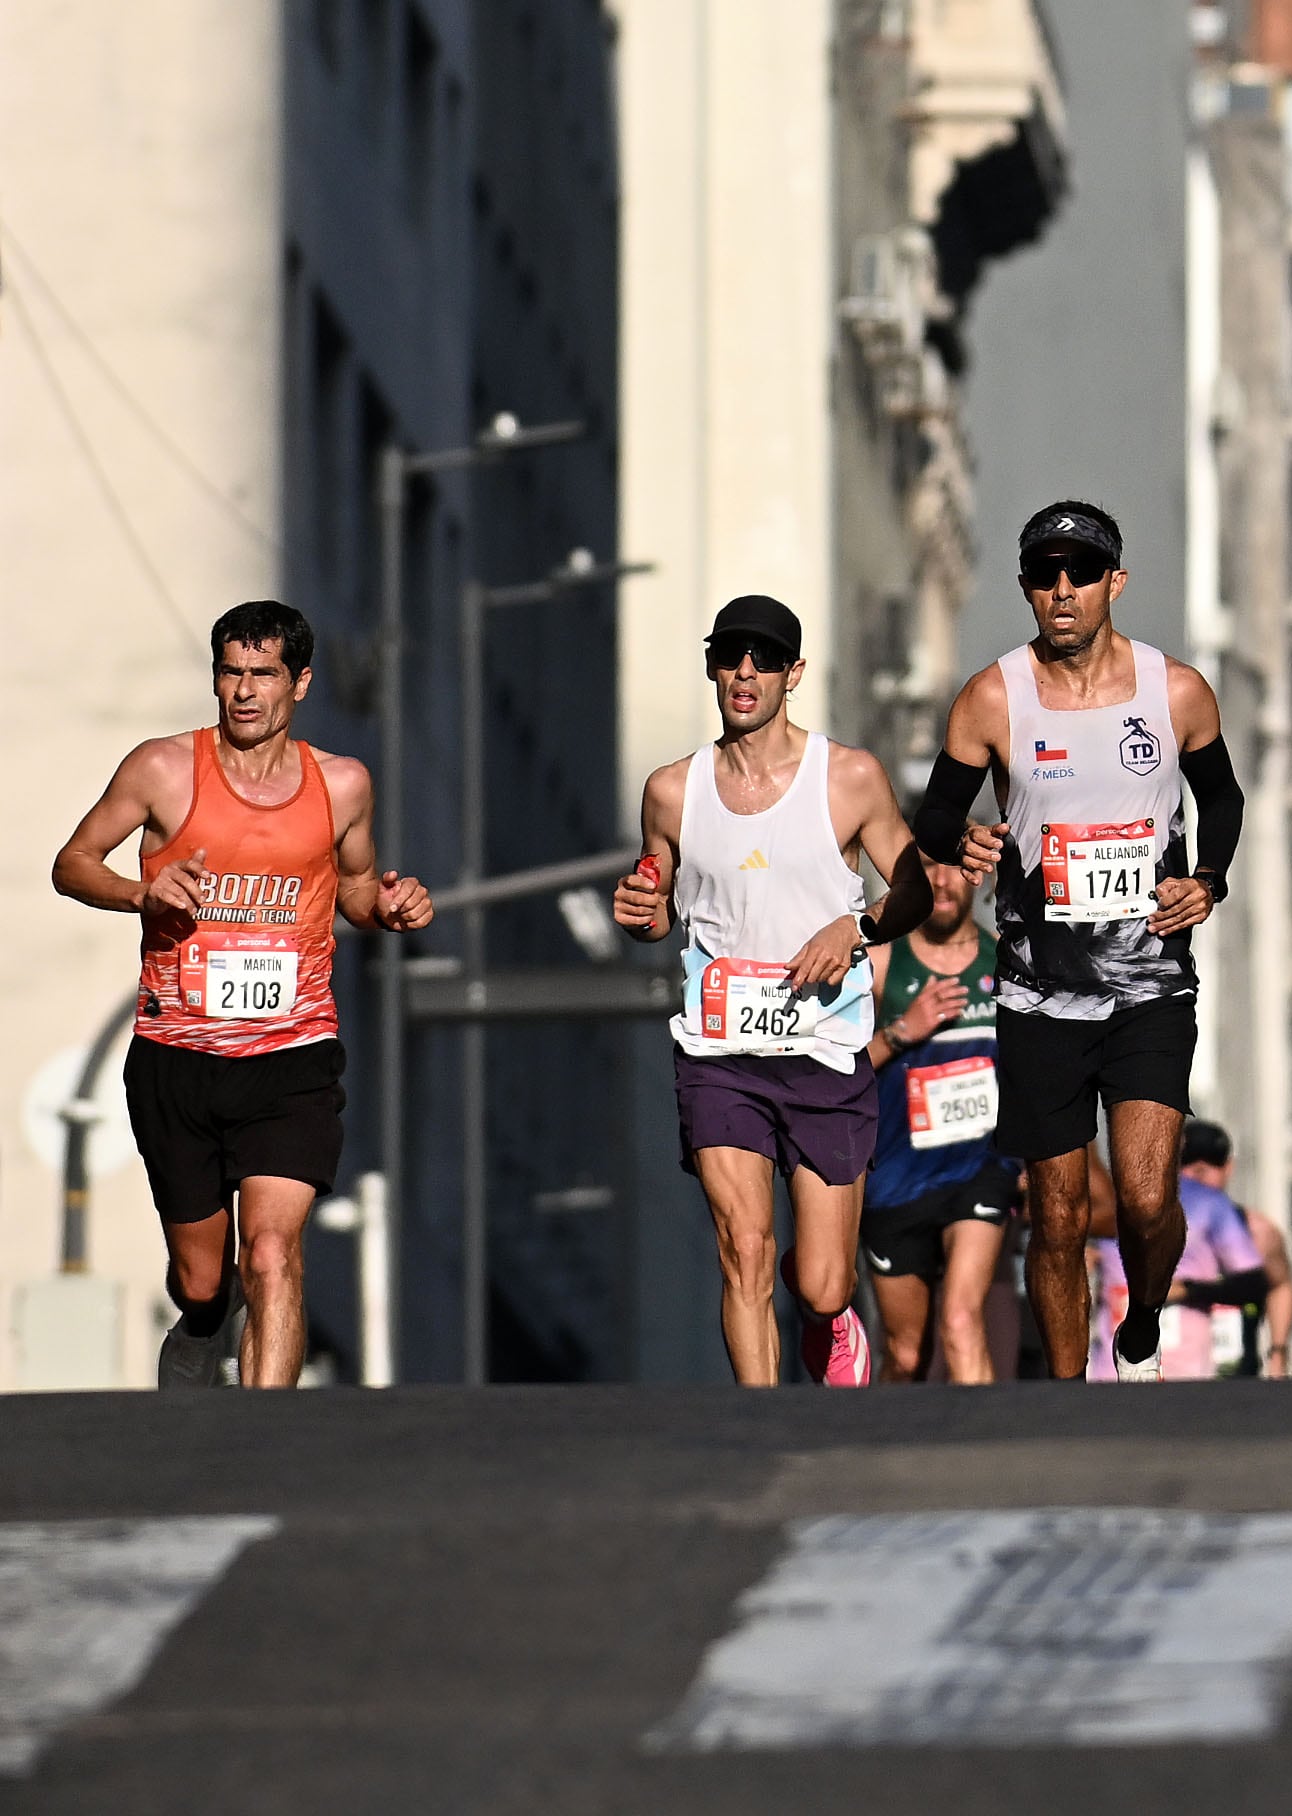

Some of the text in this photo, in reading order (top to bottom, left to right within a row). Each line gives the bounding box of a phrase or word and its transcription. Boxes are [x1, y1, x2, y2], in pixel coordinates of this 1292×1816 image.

[1128, 743, 1154, 759] TD
[1042, 767, 1074, 781] MEDS
[1049, 835, 1059, 855] C
[1094, 844, 1149, 860] ALEJANDRO
[199, 872, 302, 907] BOTIJA
[1086, 867, 1141, 899] 1741
[192, 907, 297, 925] RUNNING TEAM
[188, 943, 200, 963] C
[243, 956, 282, 971] MARTÍN
[710, 967, 720, 988] C
[221, 980, 282, 1010] 2103
[740, 1006, 800, 1036] 2462
[941, 1093, 989, 1123] 2509
